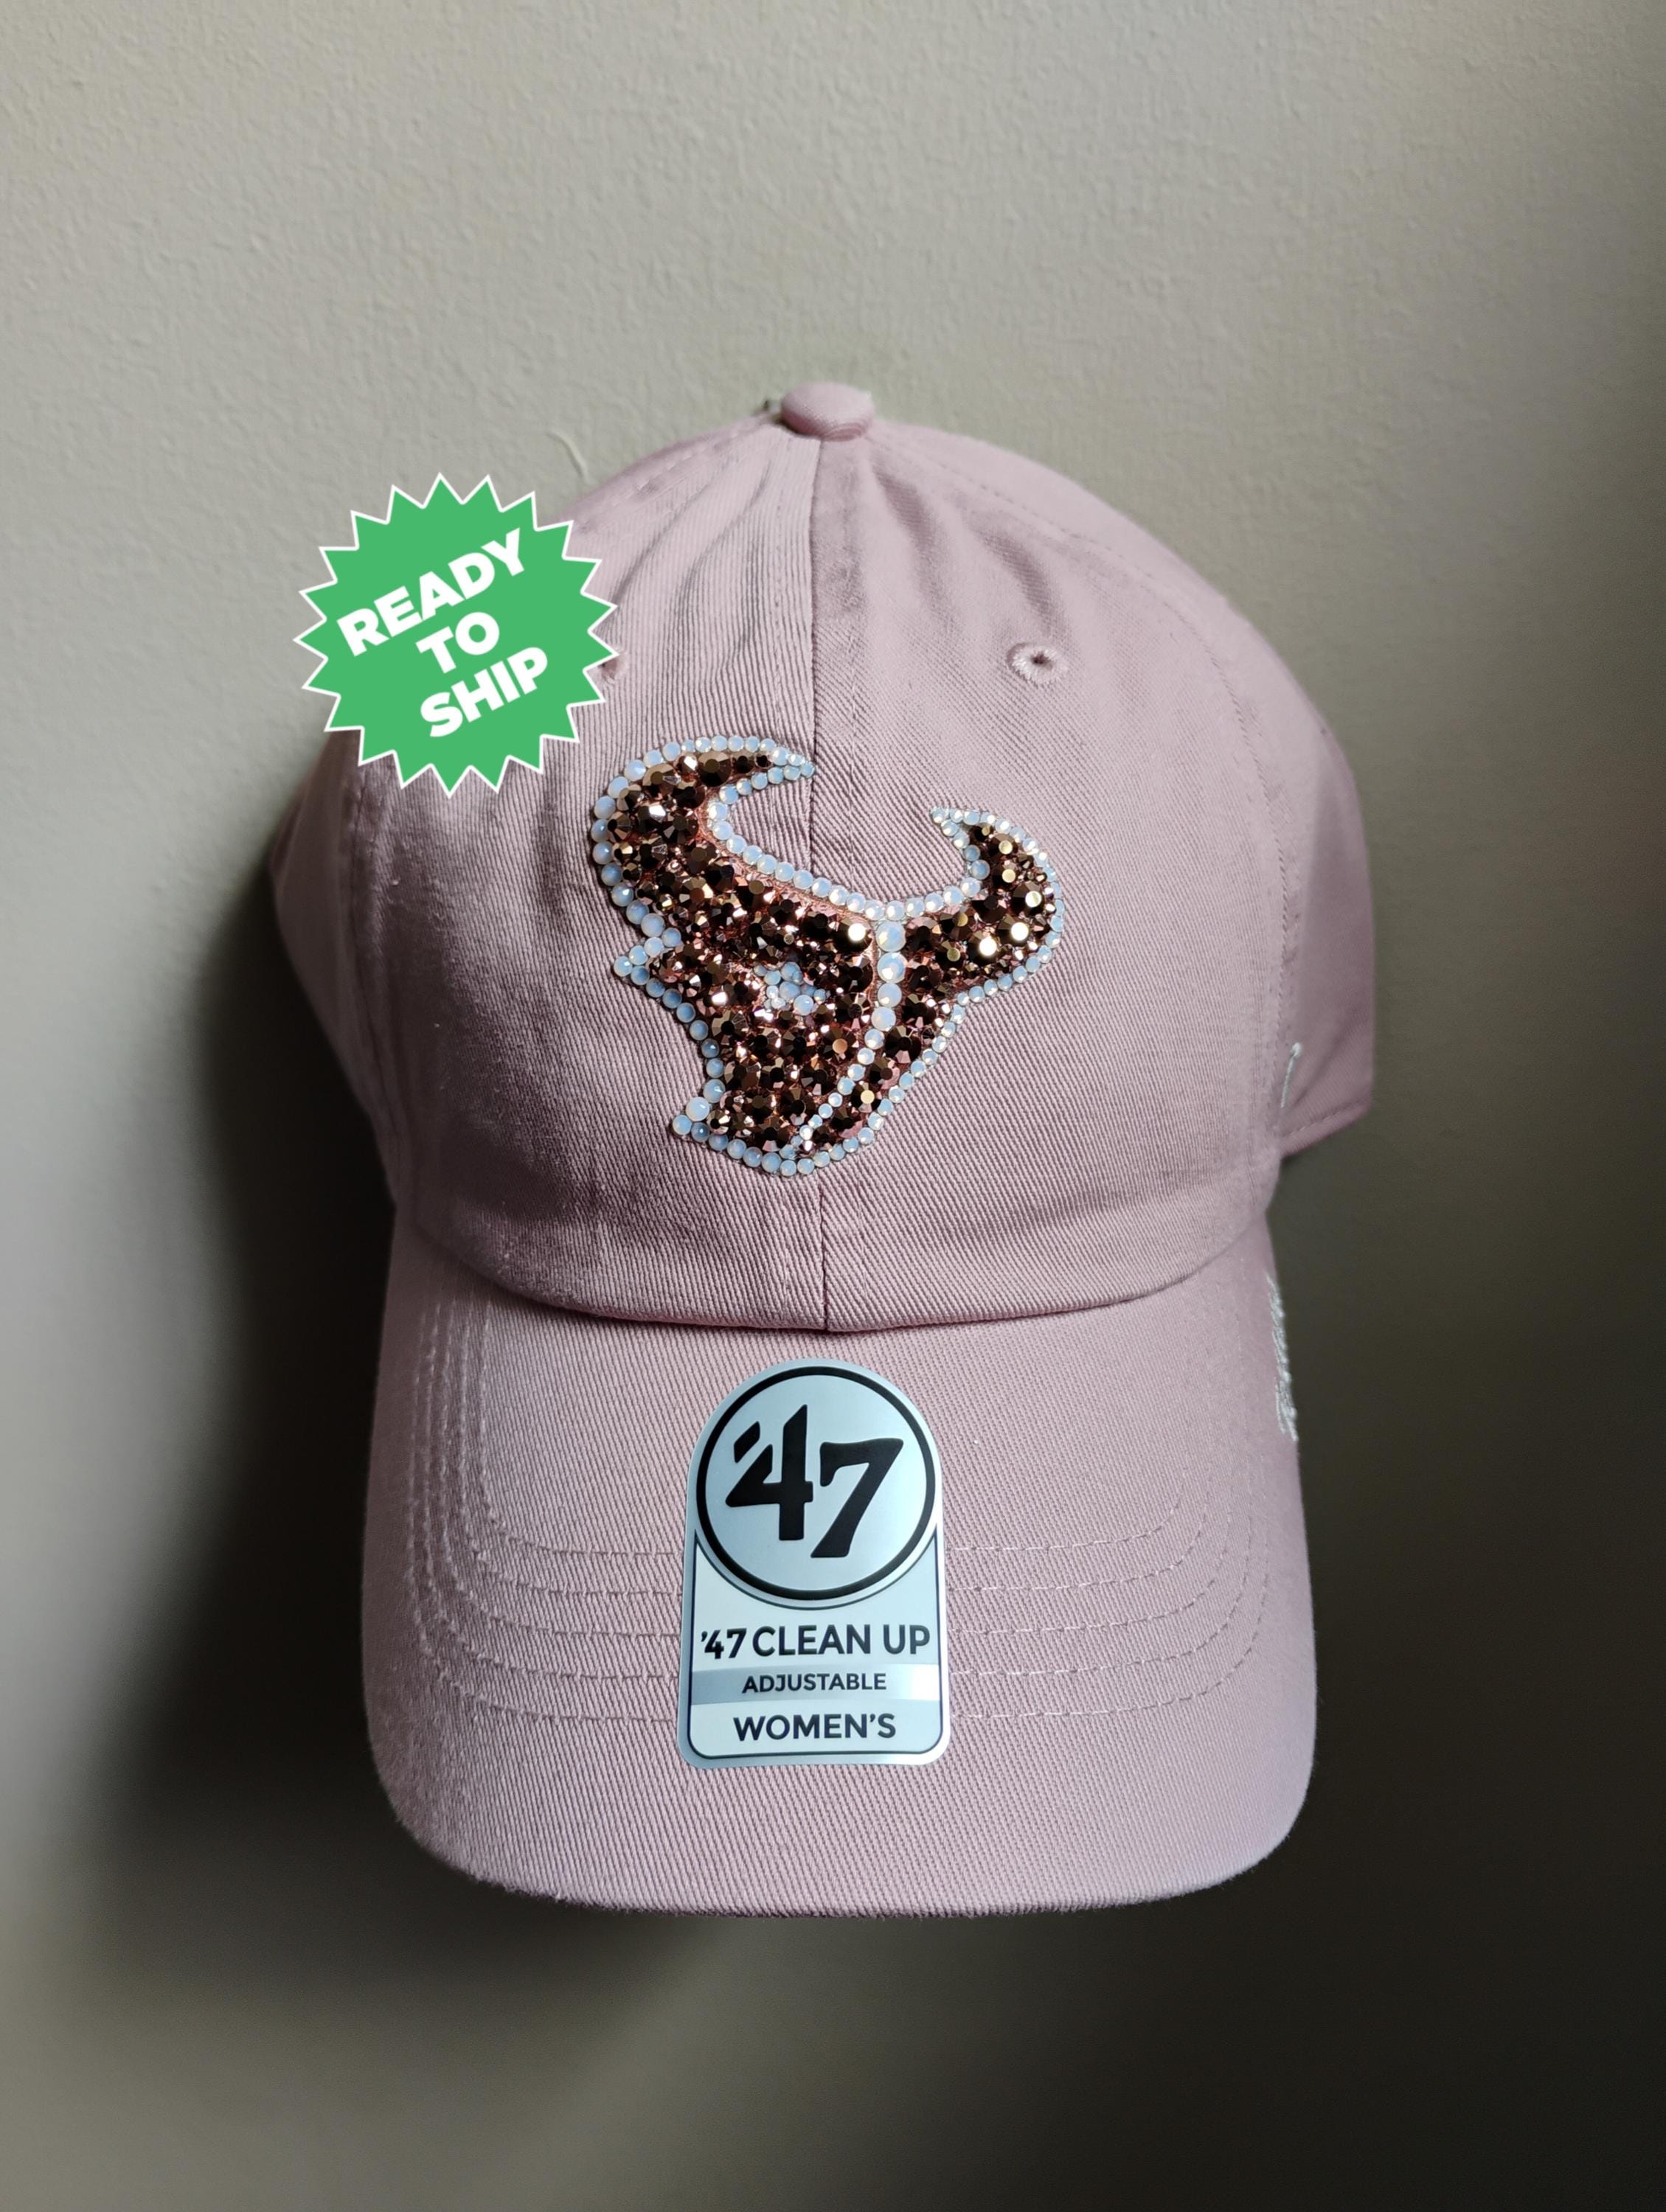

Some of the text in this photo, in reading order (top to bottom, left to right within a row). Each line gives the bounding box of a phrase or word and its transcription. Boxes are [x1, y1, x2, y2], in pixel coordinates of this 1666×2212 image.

[752, 1624, 872, 1657] CLEAN
[884, 1624, 931, 1655] UP
[742, 1672, 886, 1694] ADJUSTABLE
[733, 1713, 896, 1742] WOMEN'S
